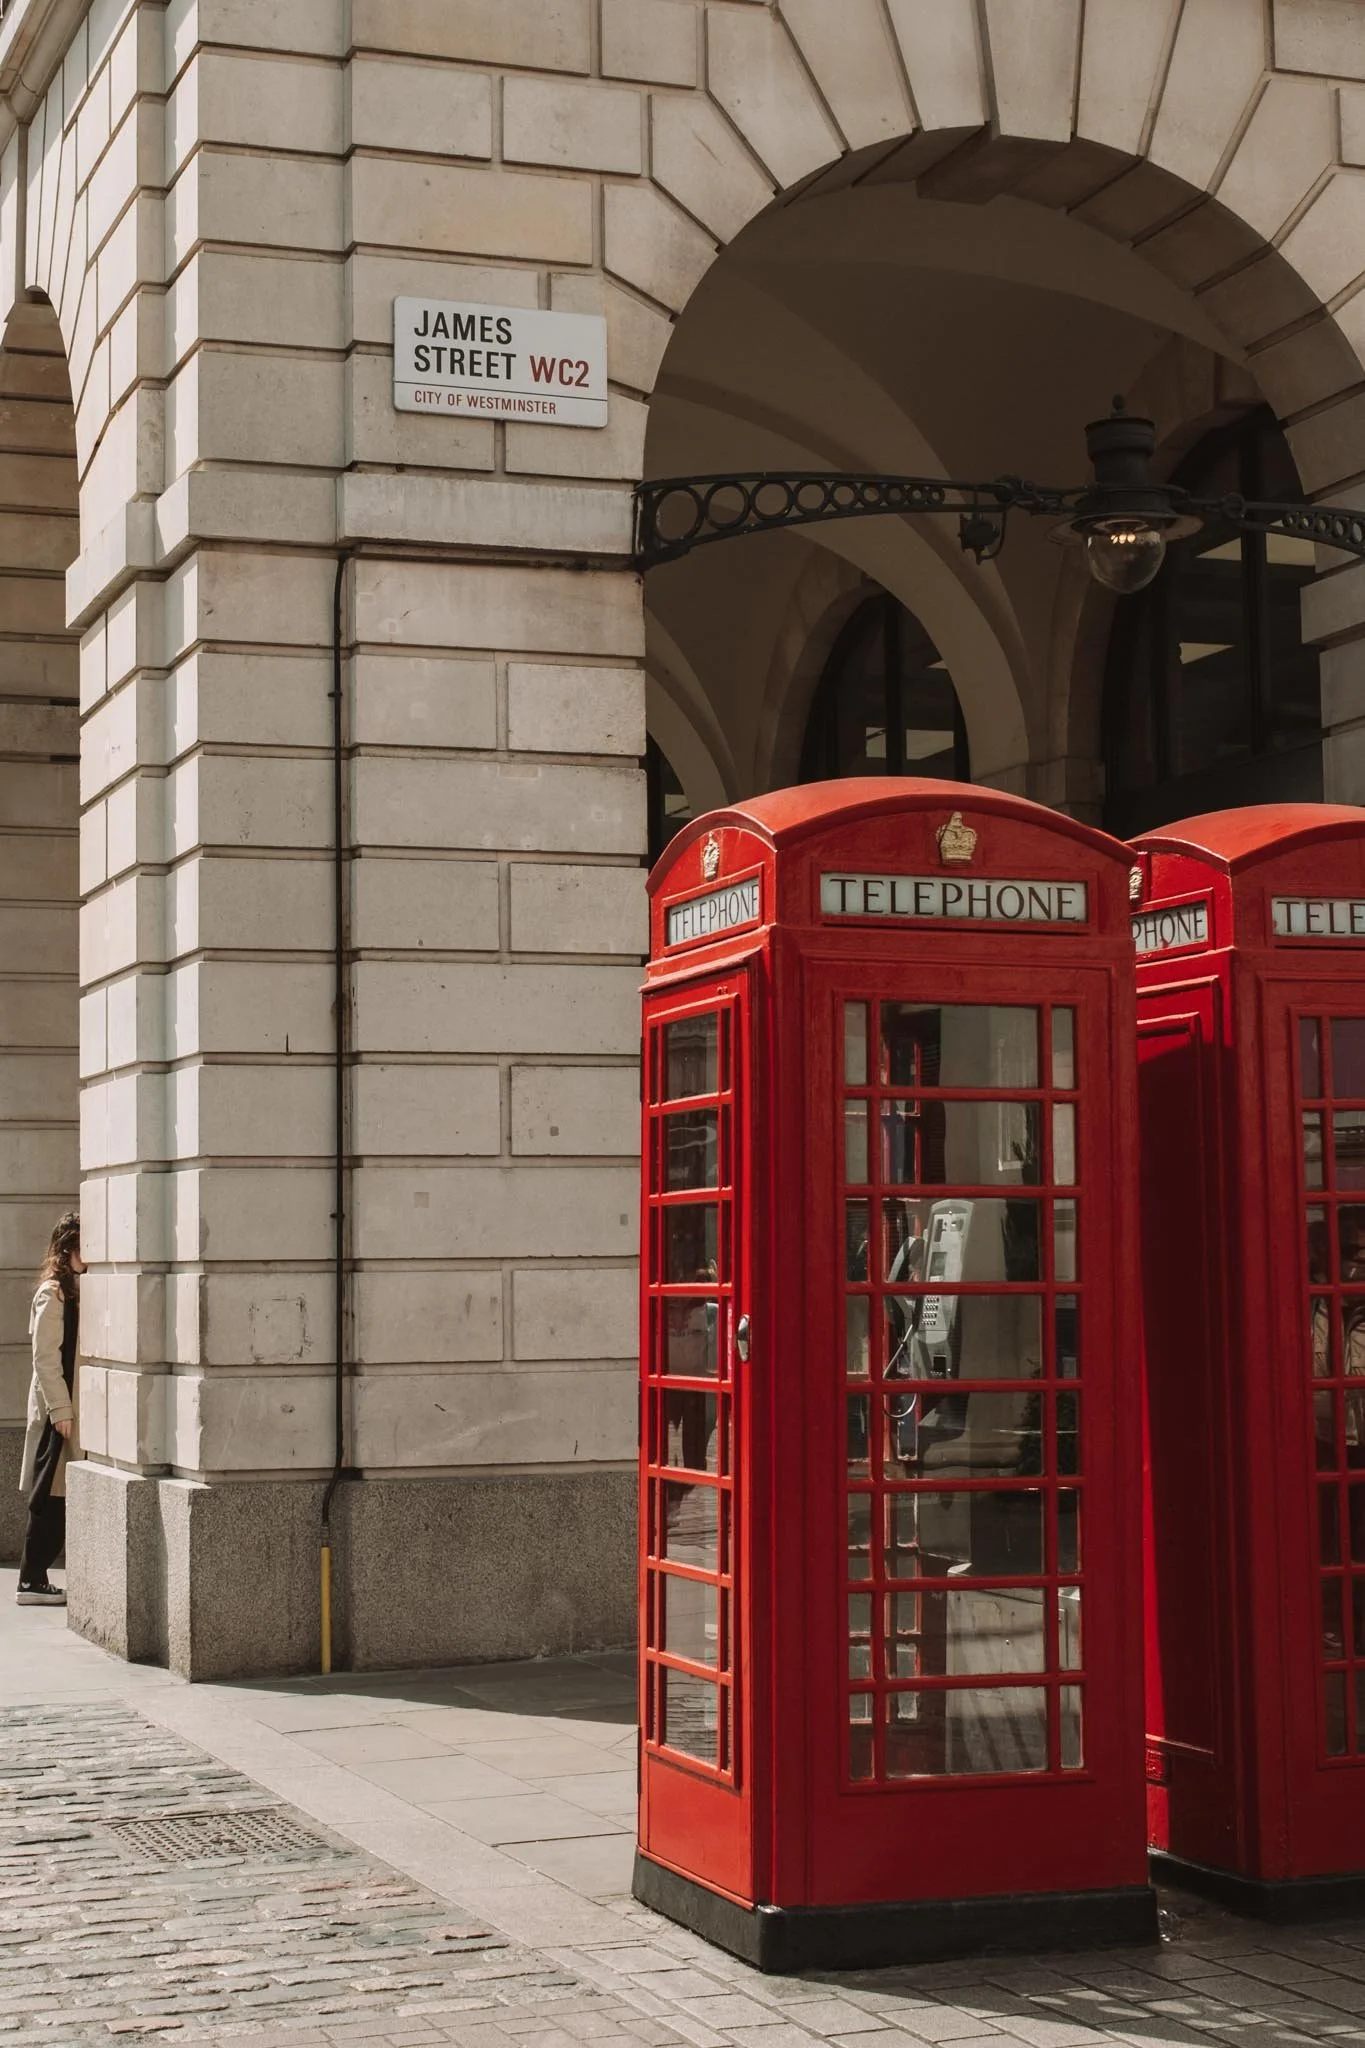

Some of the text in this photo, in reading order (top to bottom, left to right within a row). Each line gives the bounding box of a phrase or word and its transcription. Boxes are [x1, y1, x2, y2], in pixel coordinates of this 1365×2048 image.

[414, 310, 512, 345] JAMES
[414, 344, 590, 388] STREET WC2
[414, 390, 556, 415] CITY OF WESTMINSTER
[671, 884, 759, 942] TELEPHONE
[829, 878, 1077, 921] TELEPHONE
[1276, 901, 1365, 934] TELE
